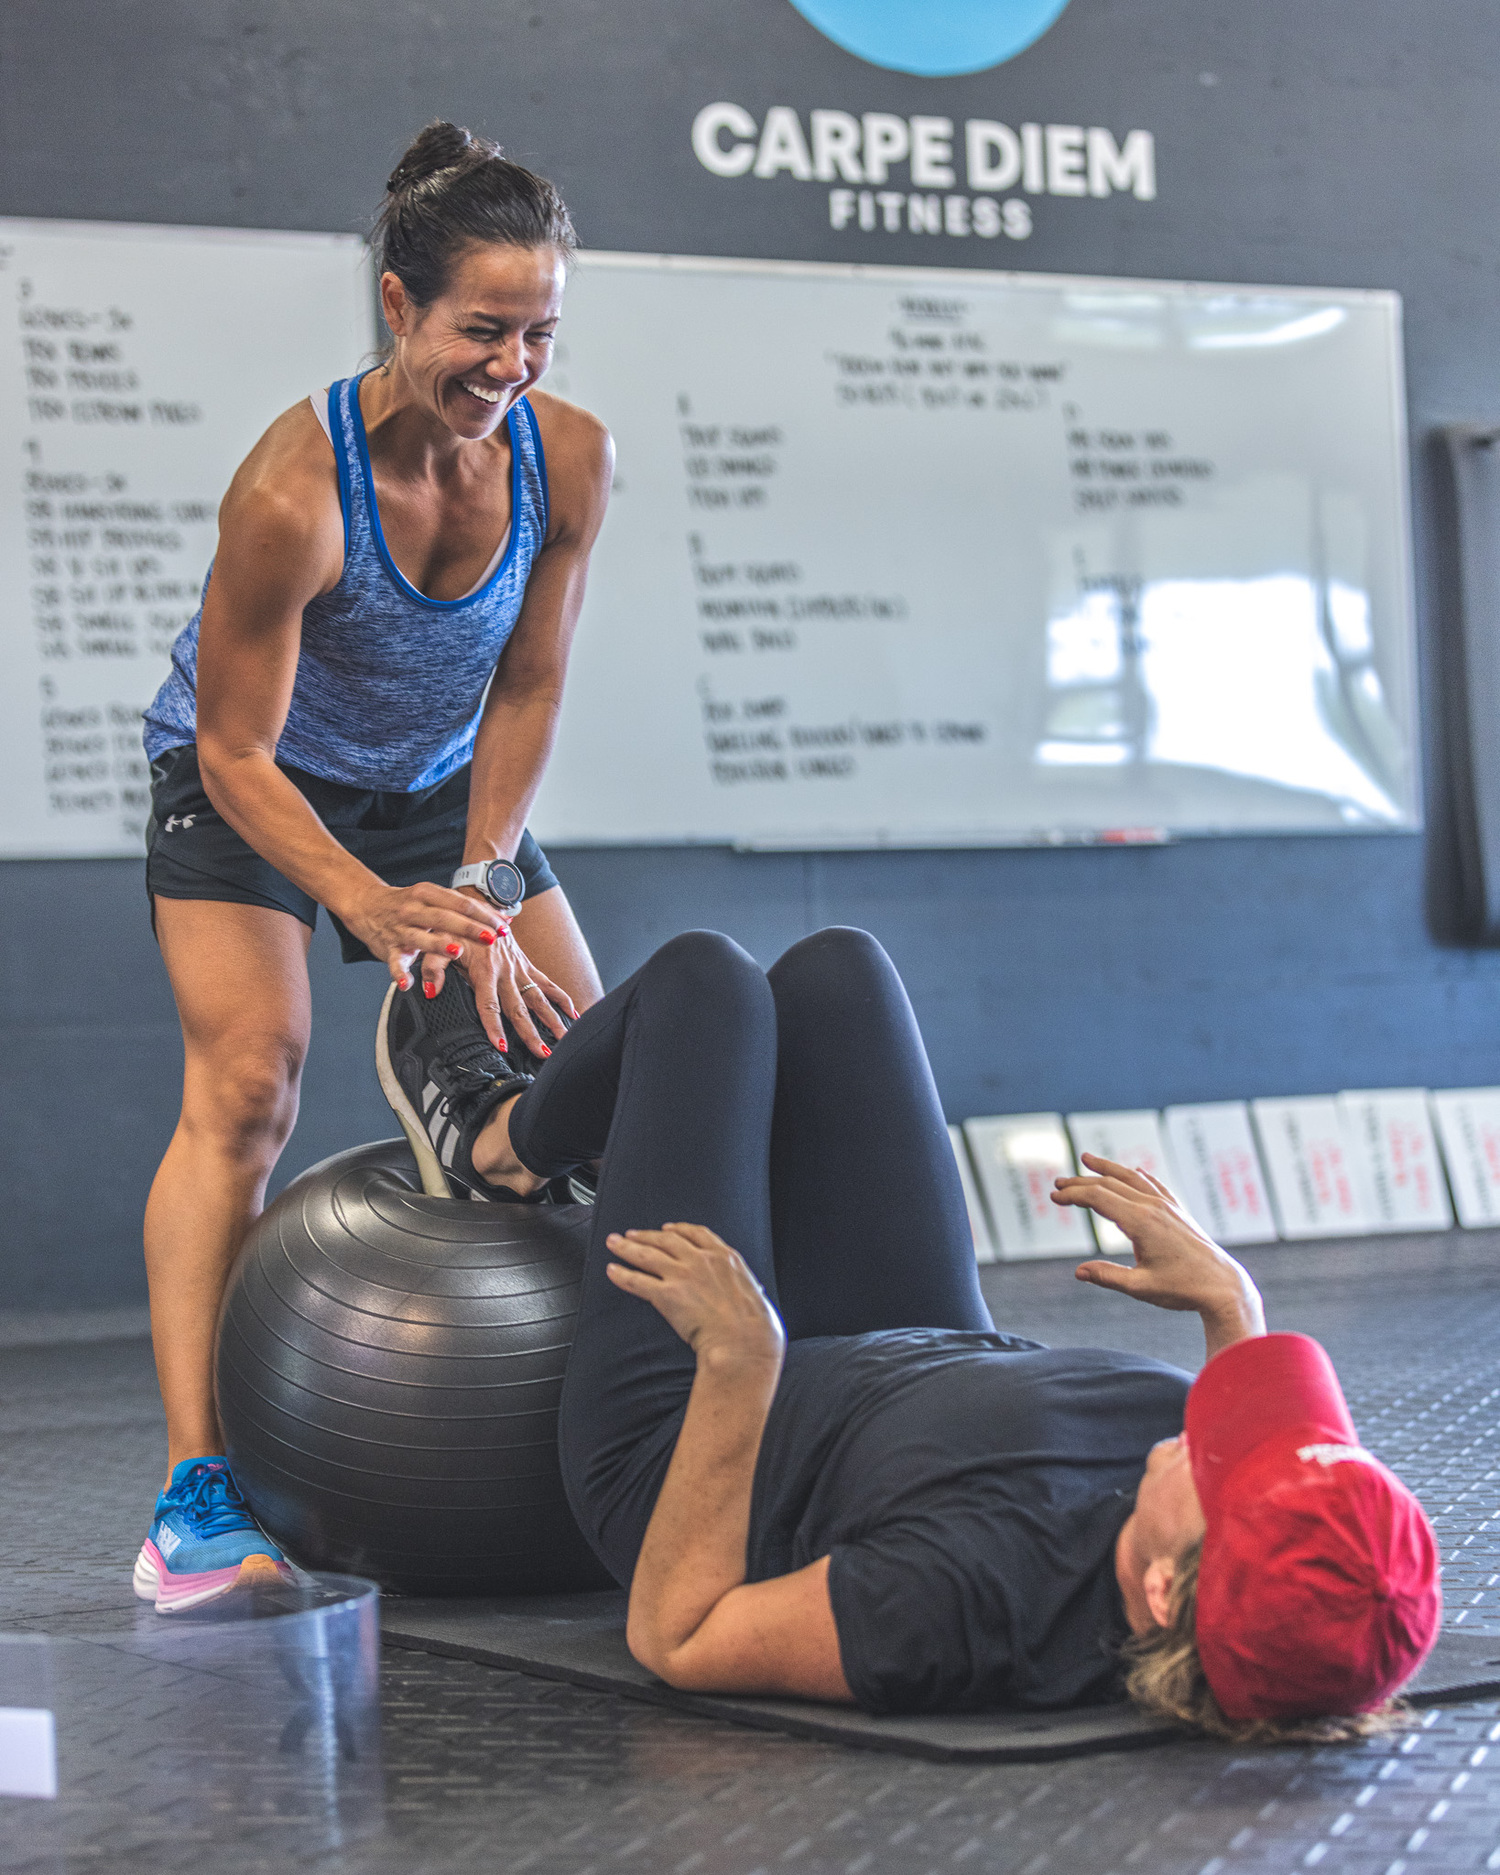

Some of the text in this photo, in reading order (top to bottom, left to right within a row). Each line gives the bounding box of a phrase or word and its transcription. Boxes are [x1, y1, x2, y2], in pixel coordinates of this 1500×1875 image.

[691, 101, 1157, 200] CARPE DIEM
[829, 188, 1033, 239] FITNESS
